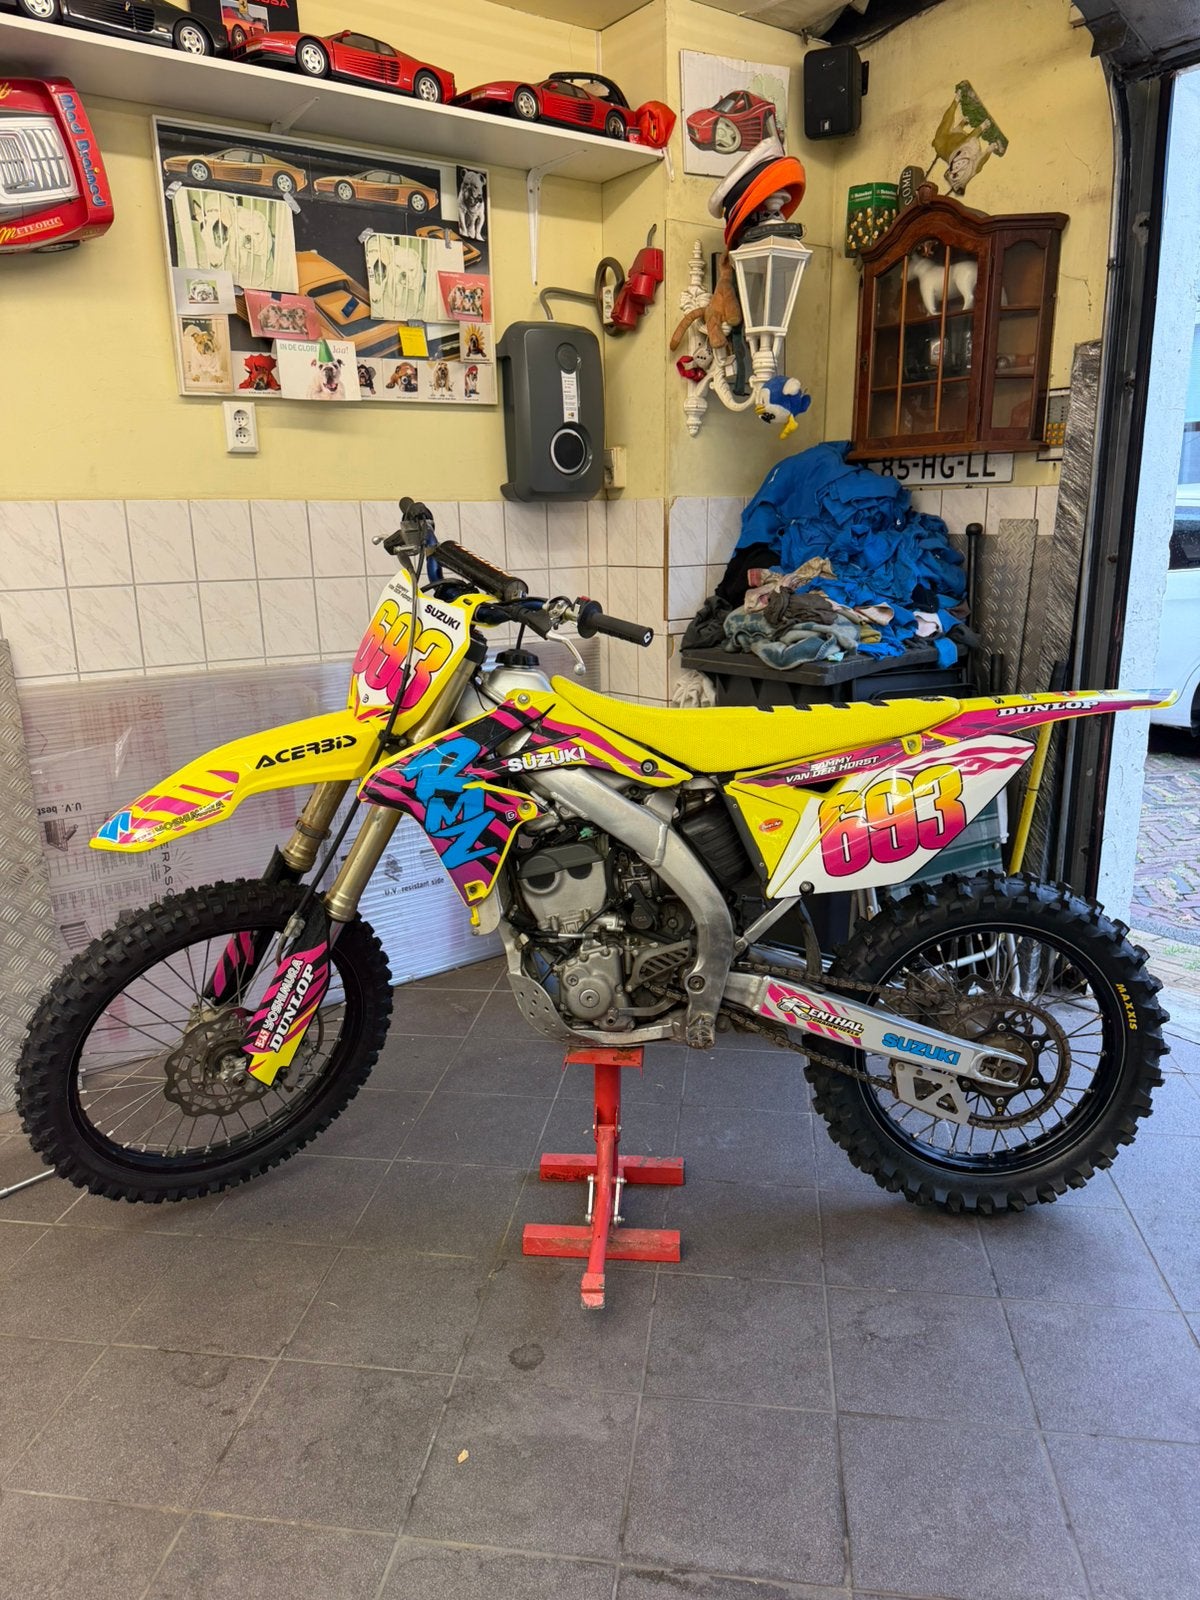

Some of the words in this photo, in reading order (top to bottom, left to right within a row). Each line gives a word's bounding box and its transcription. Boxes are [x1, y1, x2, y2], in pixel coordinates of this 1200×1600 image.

[76, 138, 107, 207] Brained
[297, 345, 318, 353] GLORI
[881, 451, 996, 480] 85-HG-LL
[424, 604, 461, 631] SUZUKI
[352, 598, 454, 710] 693
[997, 700, 1100, 718] DUNLOP
[507, 746, 587, 773] SUZUKI
[785, 771, 810, 783] VAN
[812, 765, 837, 778] DER
[839, 756, 880, 772] HORST
[810, 755, 853, 772] SAMMY
[818, 764, 967, 877] 693
[262, 956, 304, 1032] YOSHIMURA
[269, 963, 314, 1053] DUNLOP
[1115, 983, 1138, 1030] MAXXIS
[882, 1032, 961, 1066] SUZUKI
